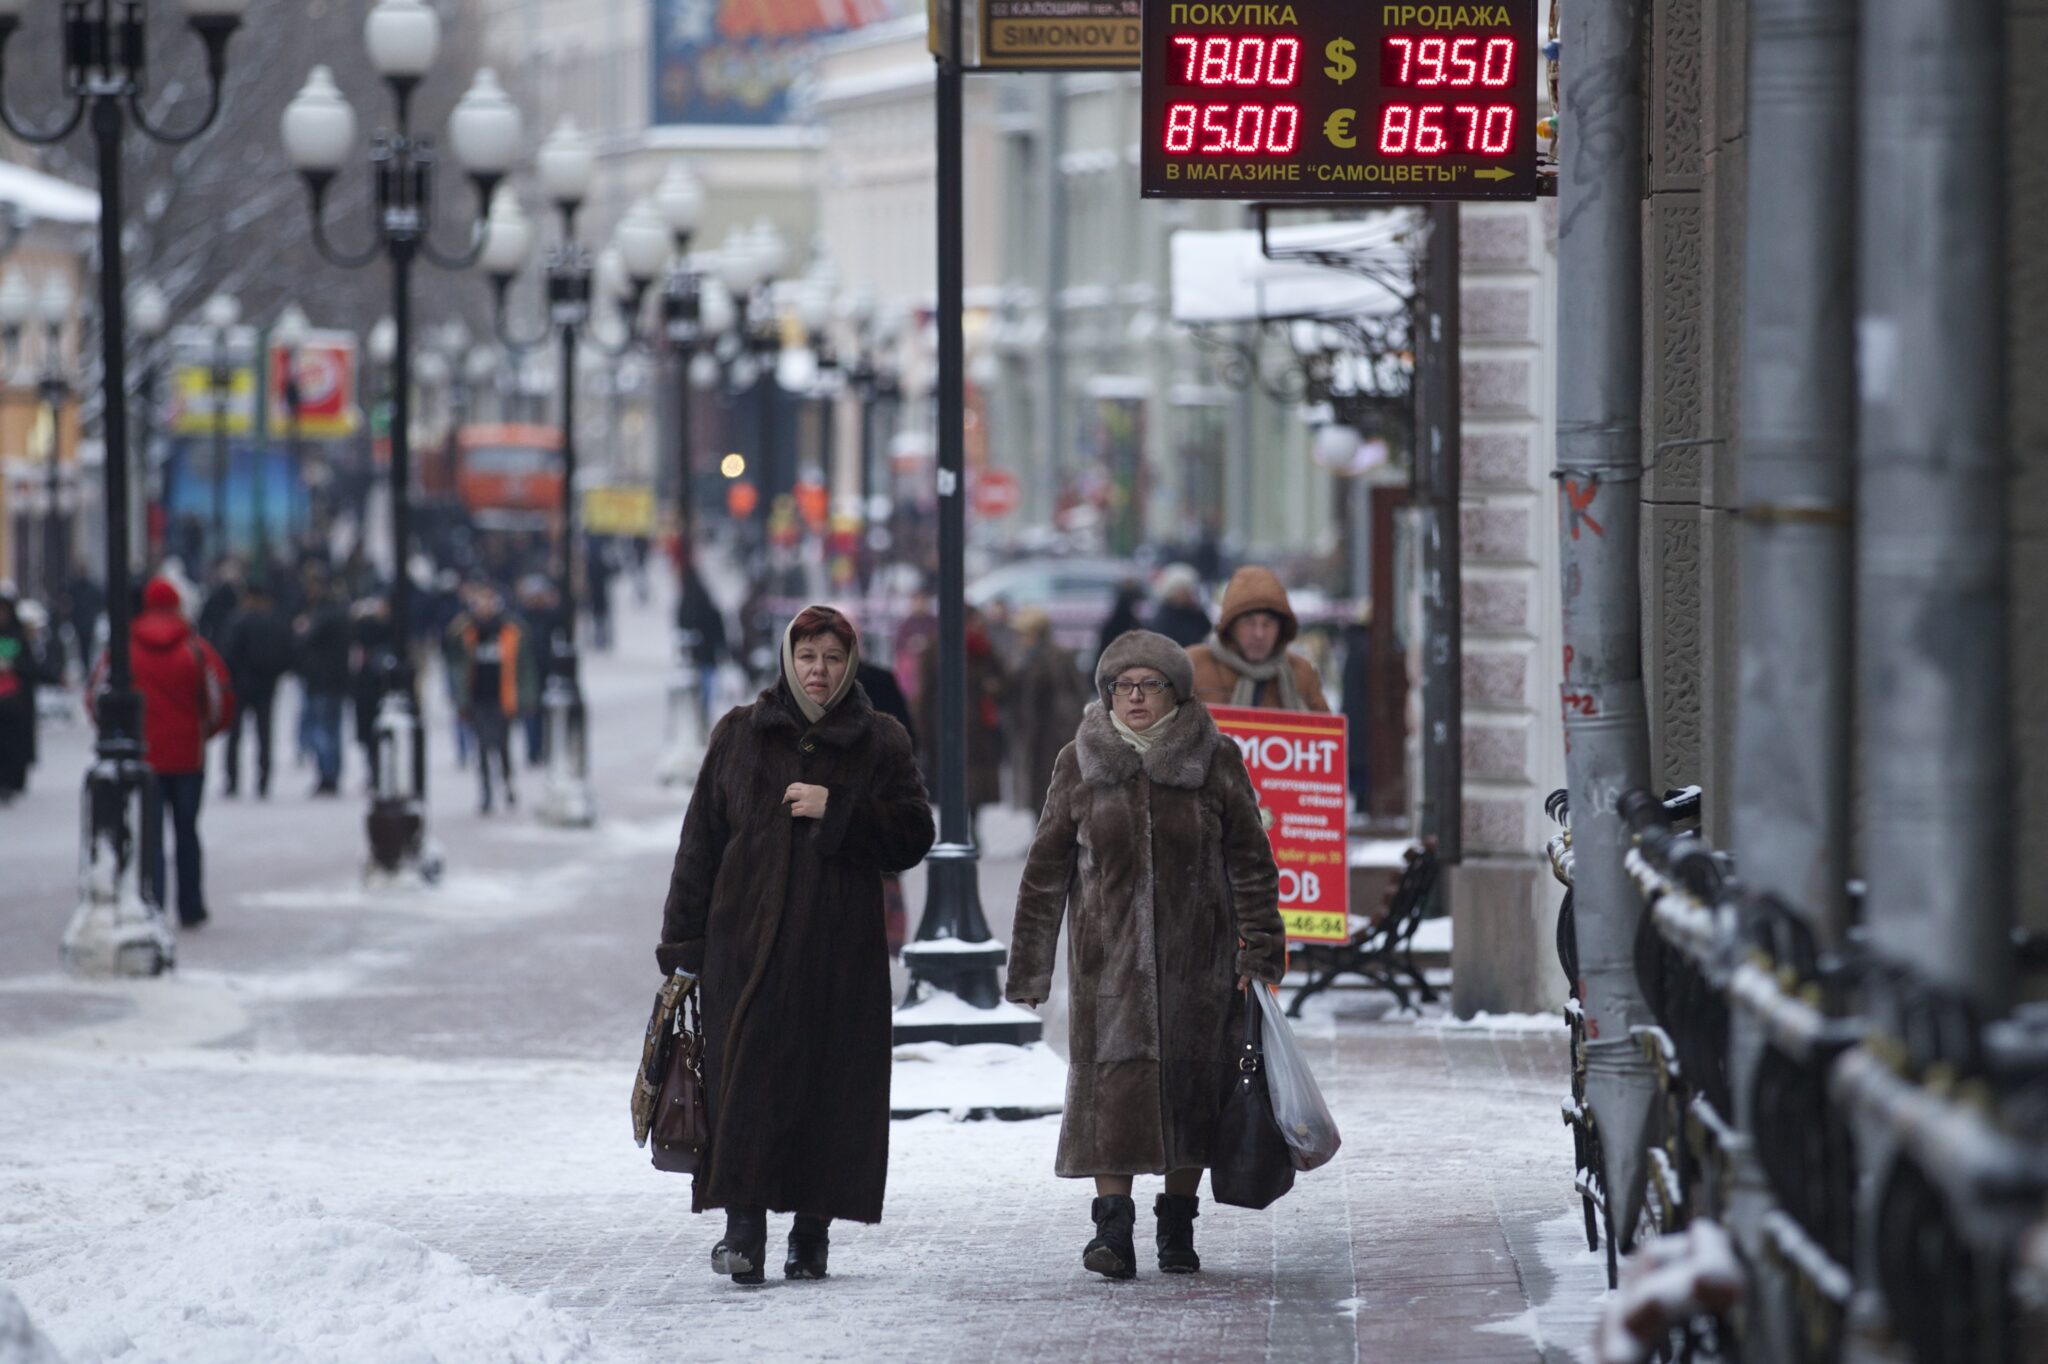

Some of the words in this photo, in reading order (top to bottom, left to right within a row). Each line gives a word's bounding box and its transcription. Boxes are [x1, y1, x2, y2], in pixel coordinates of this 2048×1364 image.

[1170, 4, 1299, 26] ПОКУПКА
[1383, 5, 1512, 30] ПРОДАЖА
[1003, 25, 1116, 46] SIMONOV
[1173, 36, 1300, 85] 78.00
[1323, 37, 1357, 85] $
[1388, 37, 1514, 86] 79.50
[1165, 104, 1299, 152] 85.00
[1322, 107, 1357, 149] €
[1379, 105, 1514, 153] 86.70
[1166, 163, 1180, 180] В
[1186, 163, 1300, 181] МАГАЗИНЕ
